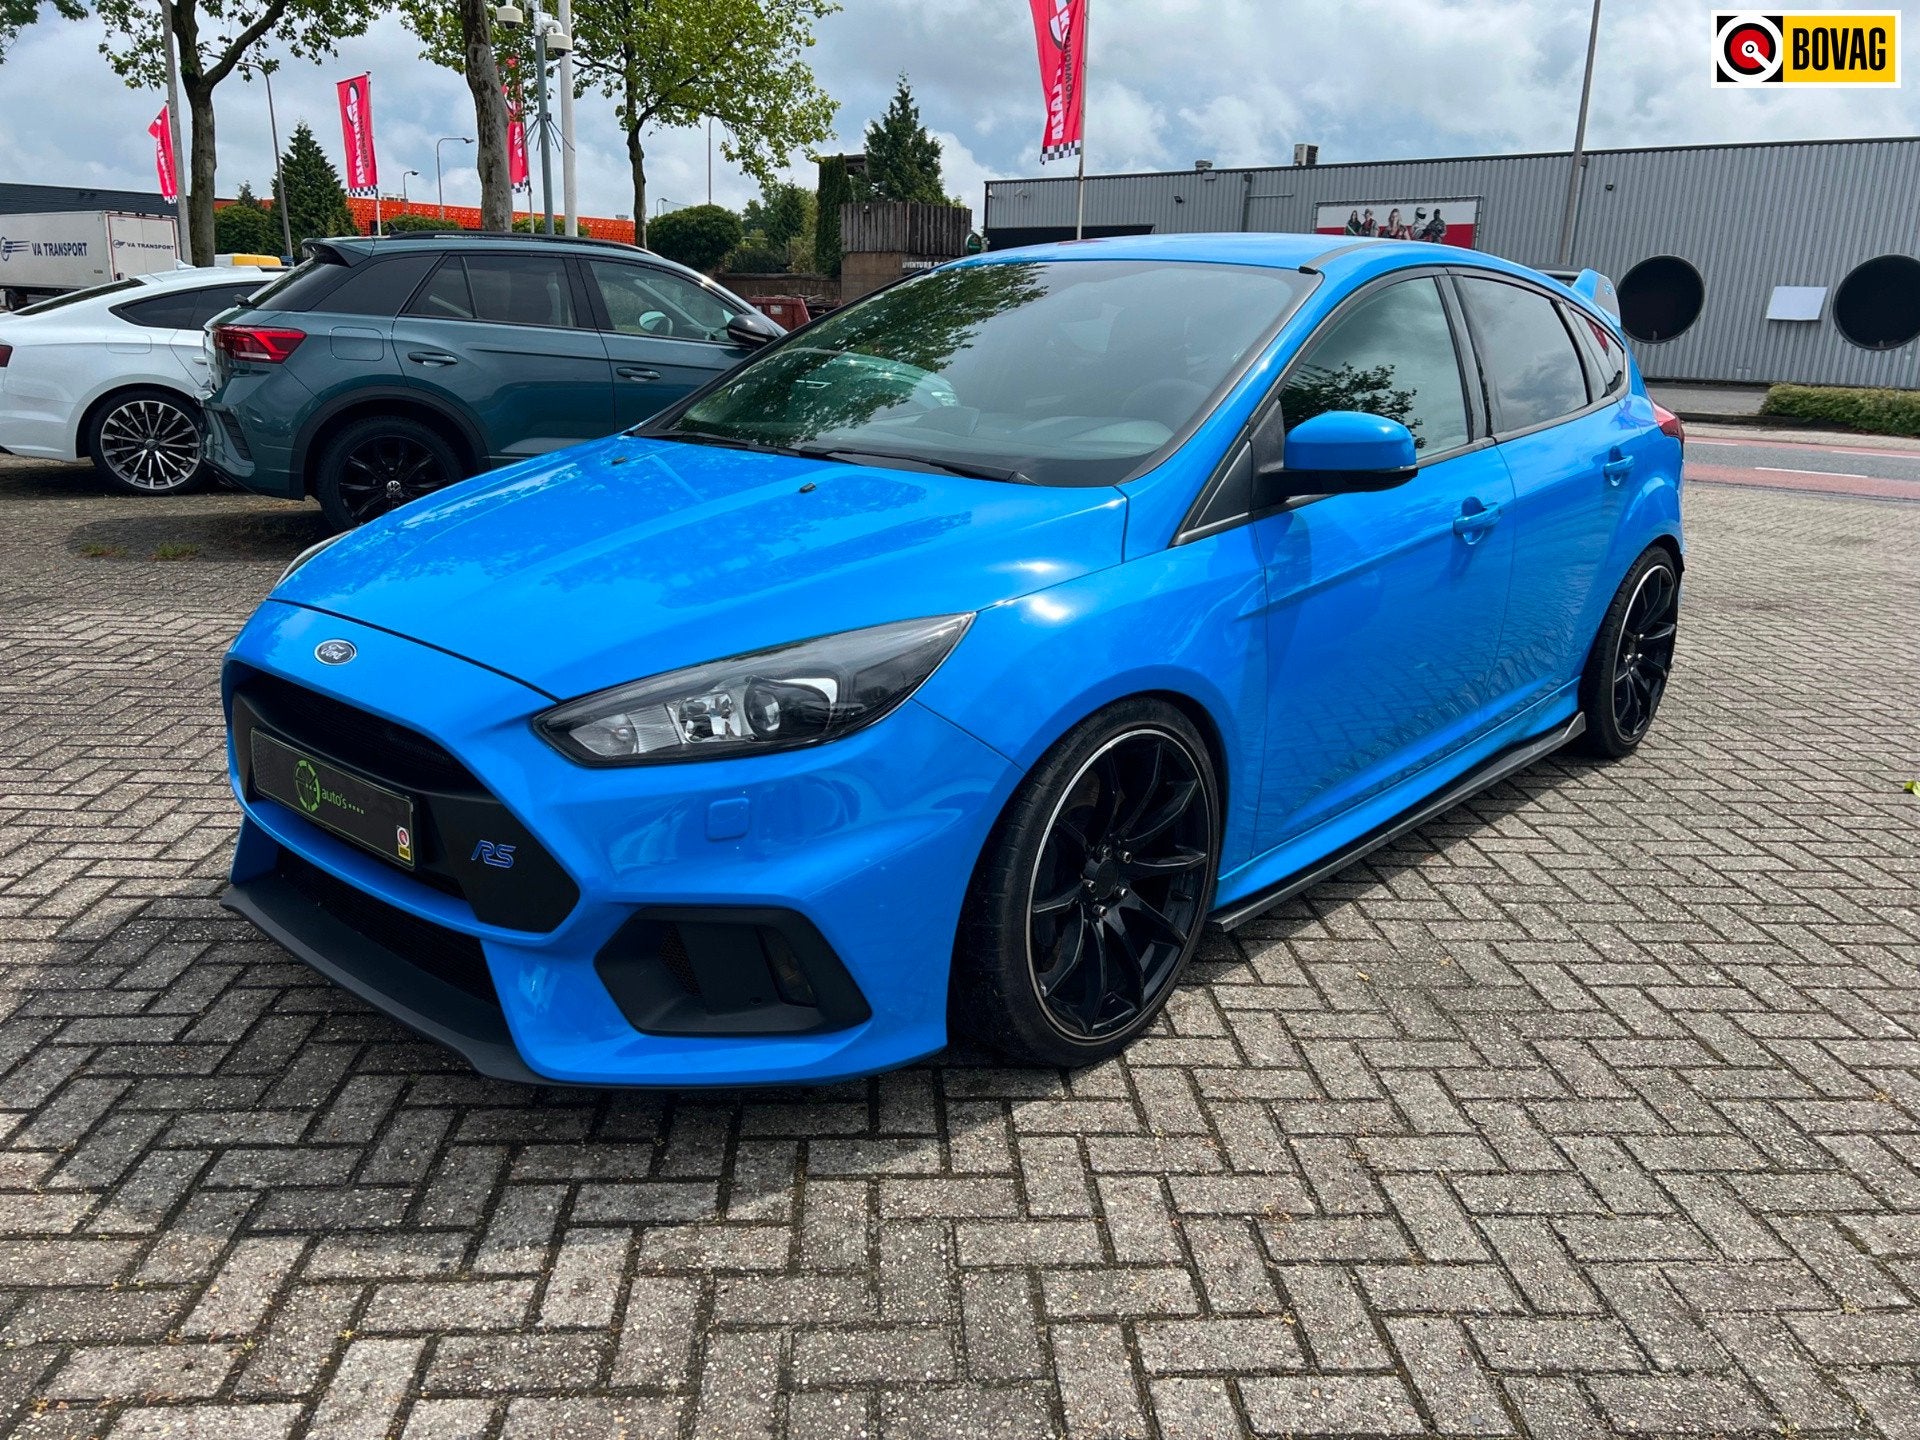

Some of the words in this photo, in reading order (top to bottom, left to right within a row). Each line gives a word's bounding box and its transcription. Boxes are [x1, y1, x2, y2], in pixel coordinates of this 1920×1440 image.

[32, 243, 43, 257] VA
[43, 242, 88, 257] TRANSPORT
[320, 644, 347, 660] Ford
[471, 839, 517, 869] RS
